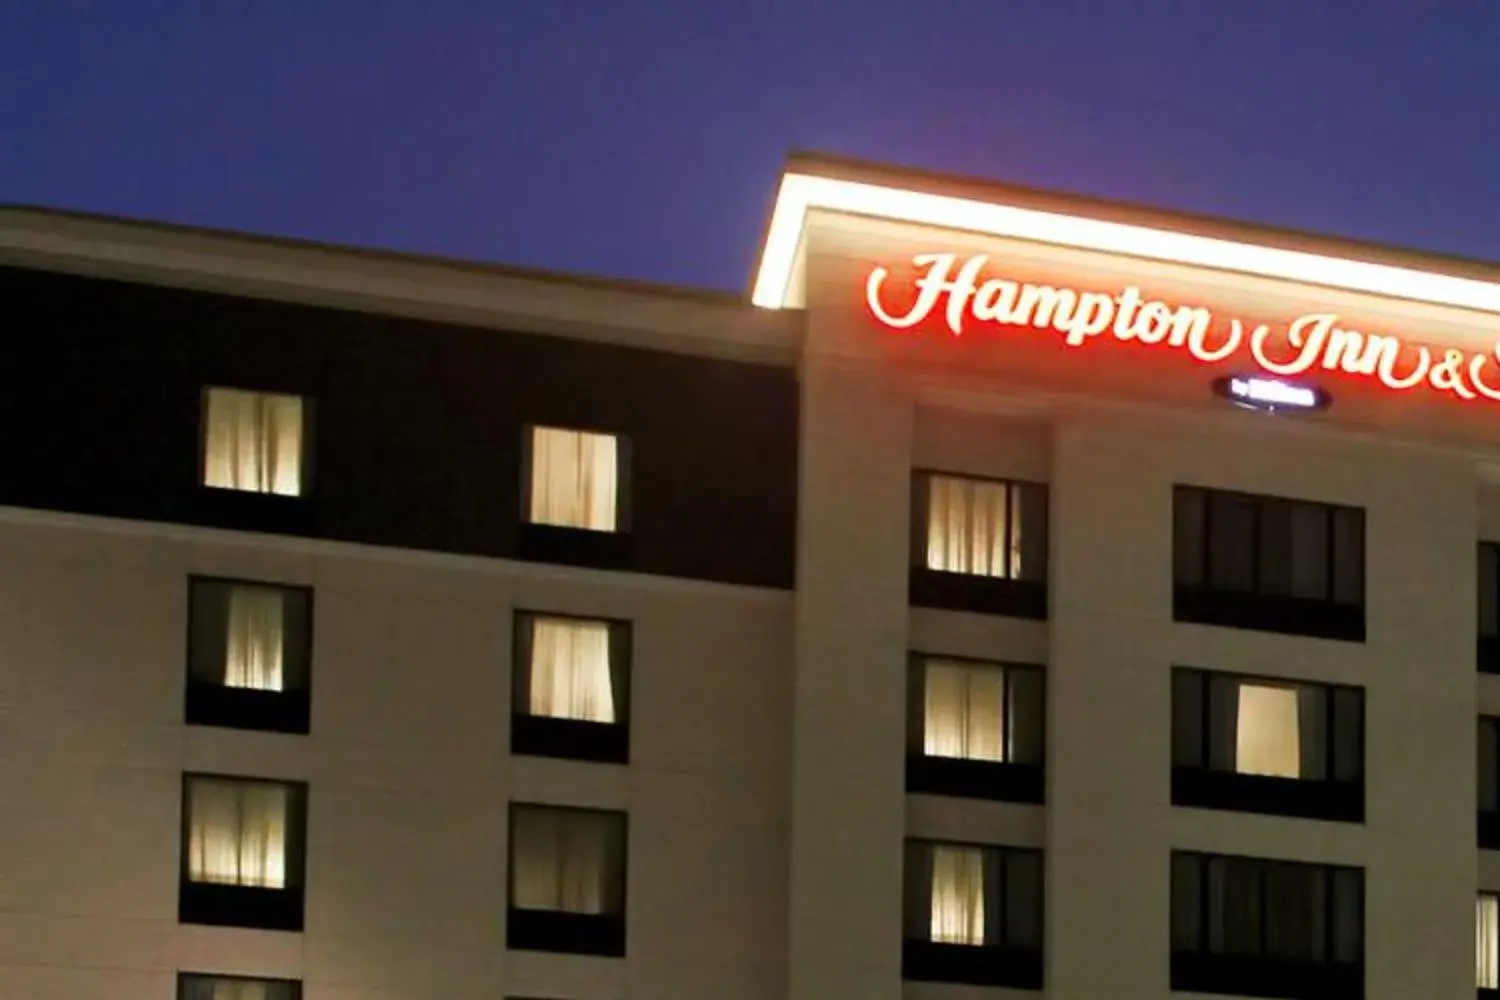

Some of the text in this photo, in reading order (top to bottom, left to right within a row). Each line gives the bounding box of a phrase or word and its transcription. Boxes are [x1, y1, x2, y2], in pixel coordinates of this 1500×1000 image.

[866, 253, 1242, 361] Hampton
[1251, 314, 1430, 389] Inn
[1430, 348, 1475, 399] &
